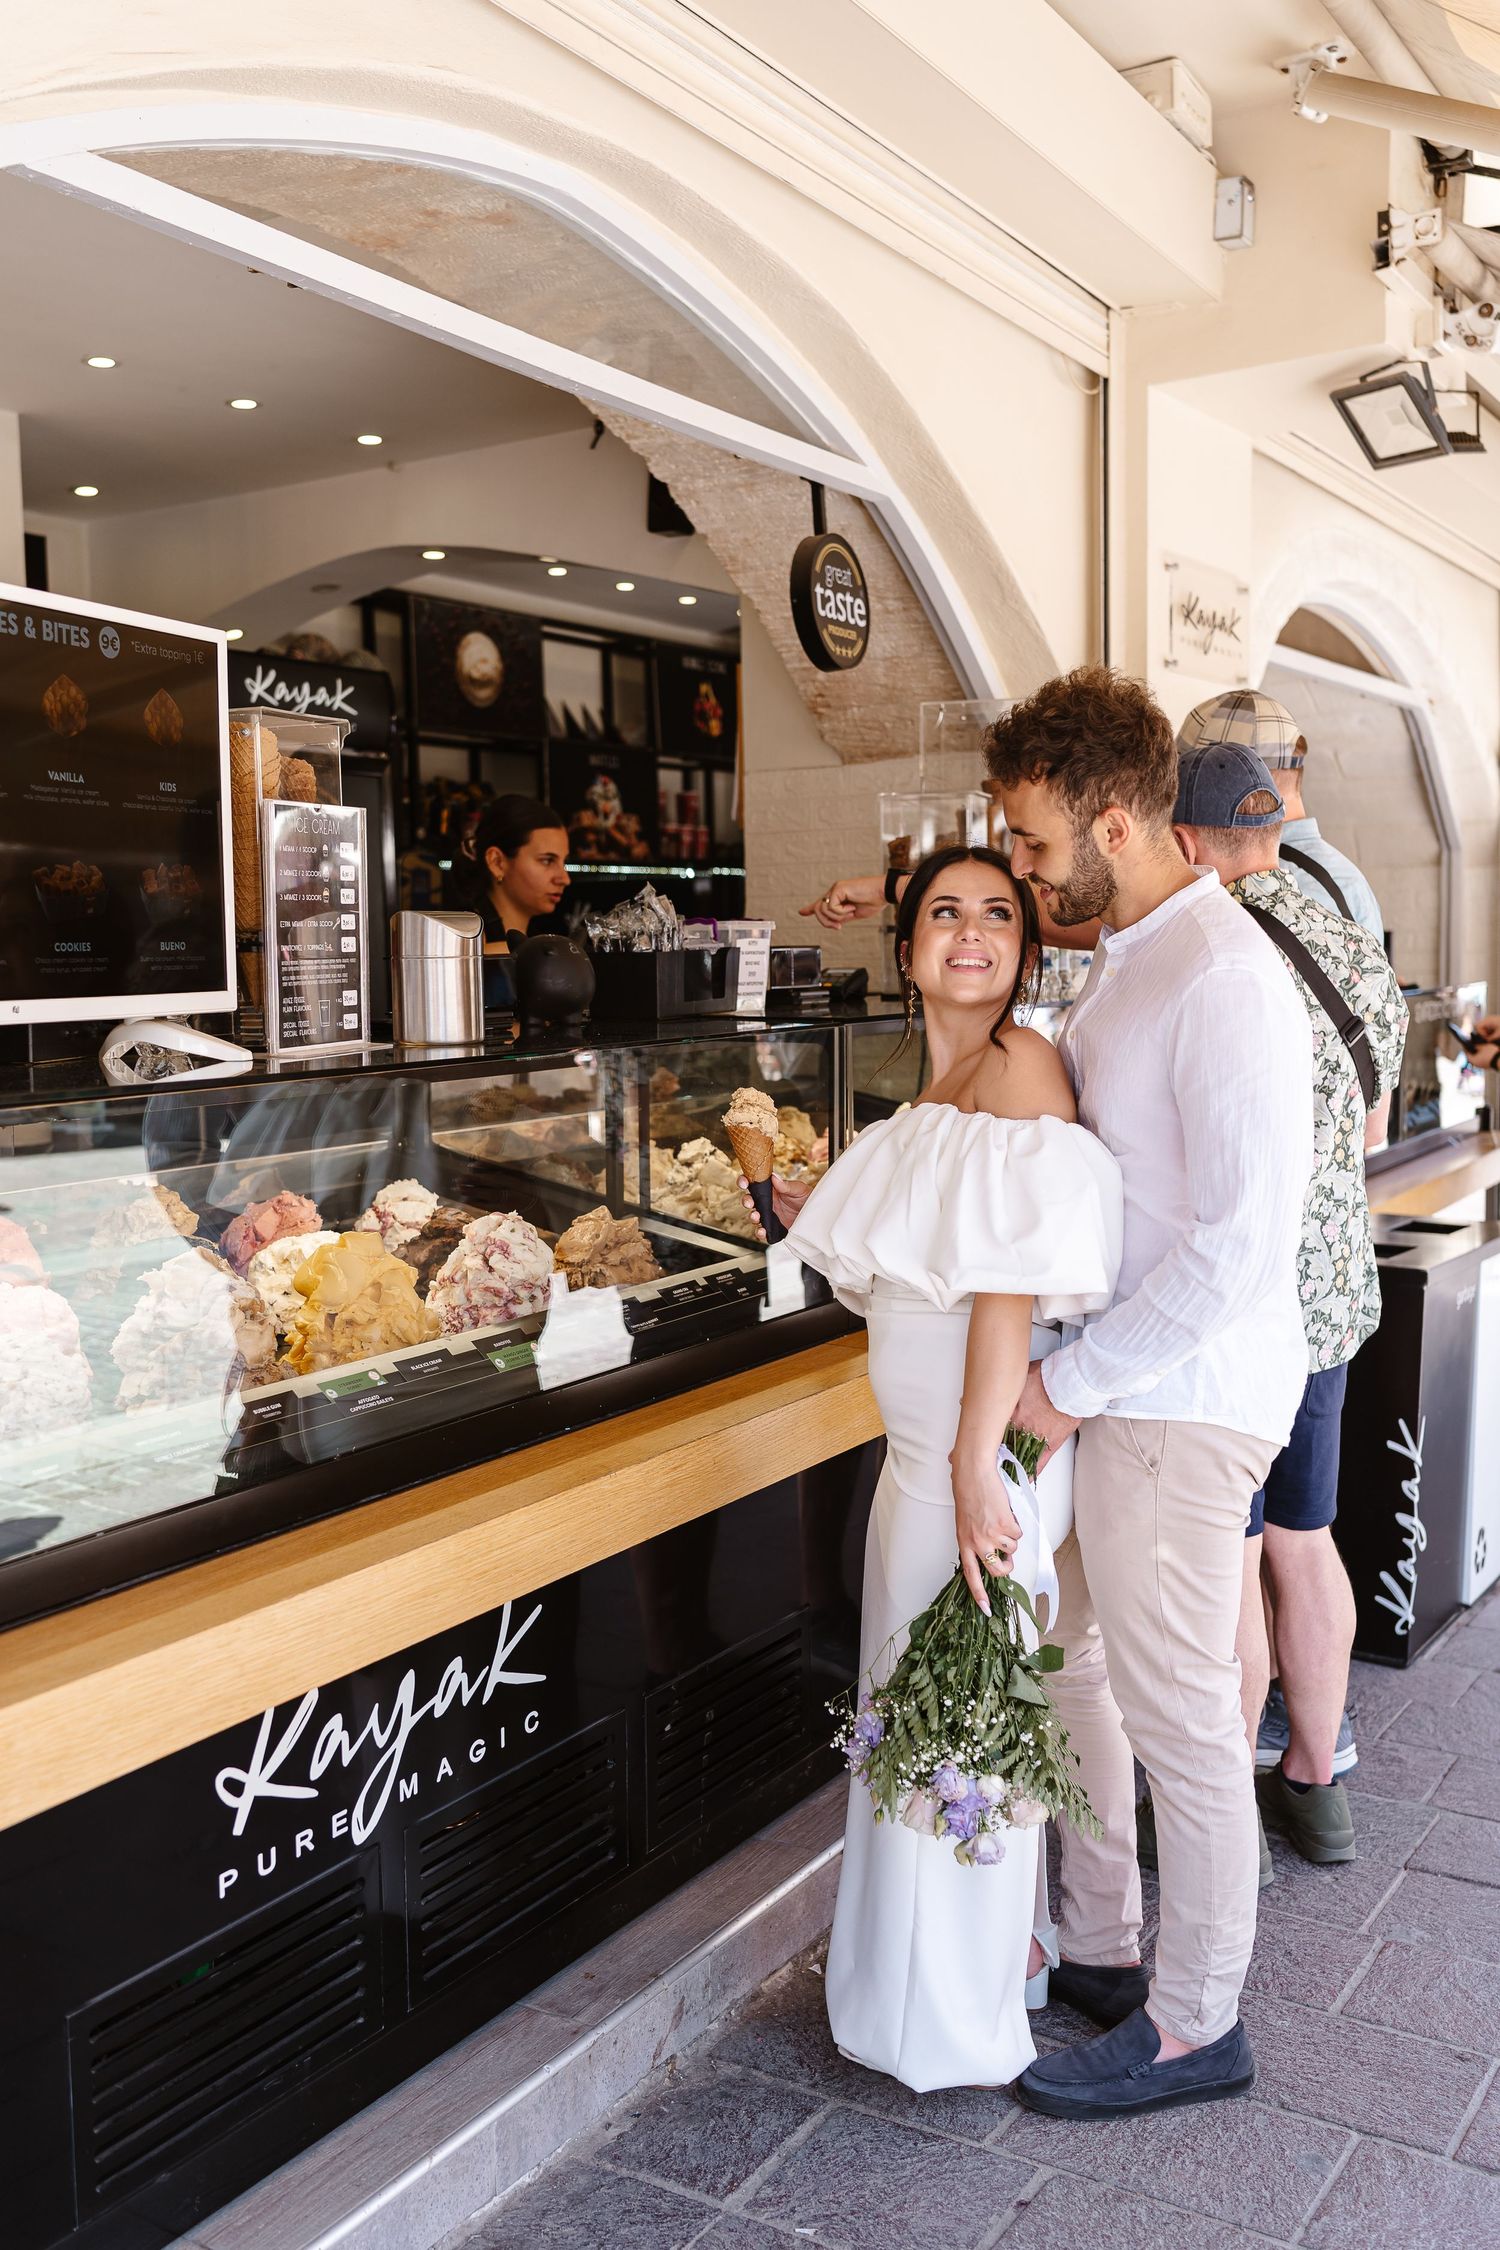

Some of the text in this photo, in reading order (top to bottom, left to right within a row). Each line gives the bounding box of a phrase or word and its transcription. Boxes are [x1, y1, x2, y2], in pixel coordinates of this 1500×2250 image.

[825, 565, 853, 588] great
[815, 582, 867, 627] taste
[1181, 591, 1241, 655] Kayak
[24, 616, 37, 639] &
[42, 619, 90, 648] BITES
[160, 648, 191, 663] topping
[244, 665, 358, 716] Kayak
[48, 770, 85, 784] VANILLA
[159, 782, 177, 793] KIDS
[311, 818, 340, 835] CREAM
[54, 942, 91, 952] COOKIES
[160, 941, 186, 951] BUENO
[350, 1396, 395, 1413] CAPPUCCINO BAILEYS
[358, 1394, 380, 1405] AFFOGATO
[252, 1404, 271, 1415] BUBBLE
[270, 1402, 282, 1411] GUM
[1375, 1415, 1427, 1636] Kayak
[215, 1600, 547, 1845] Kayak
[218, 1710, 540, 1899] PURE MAGIC
